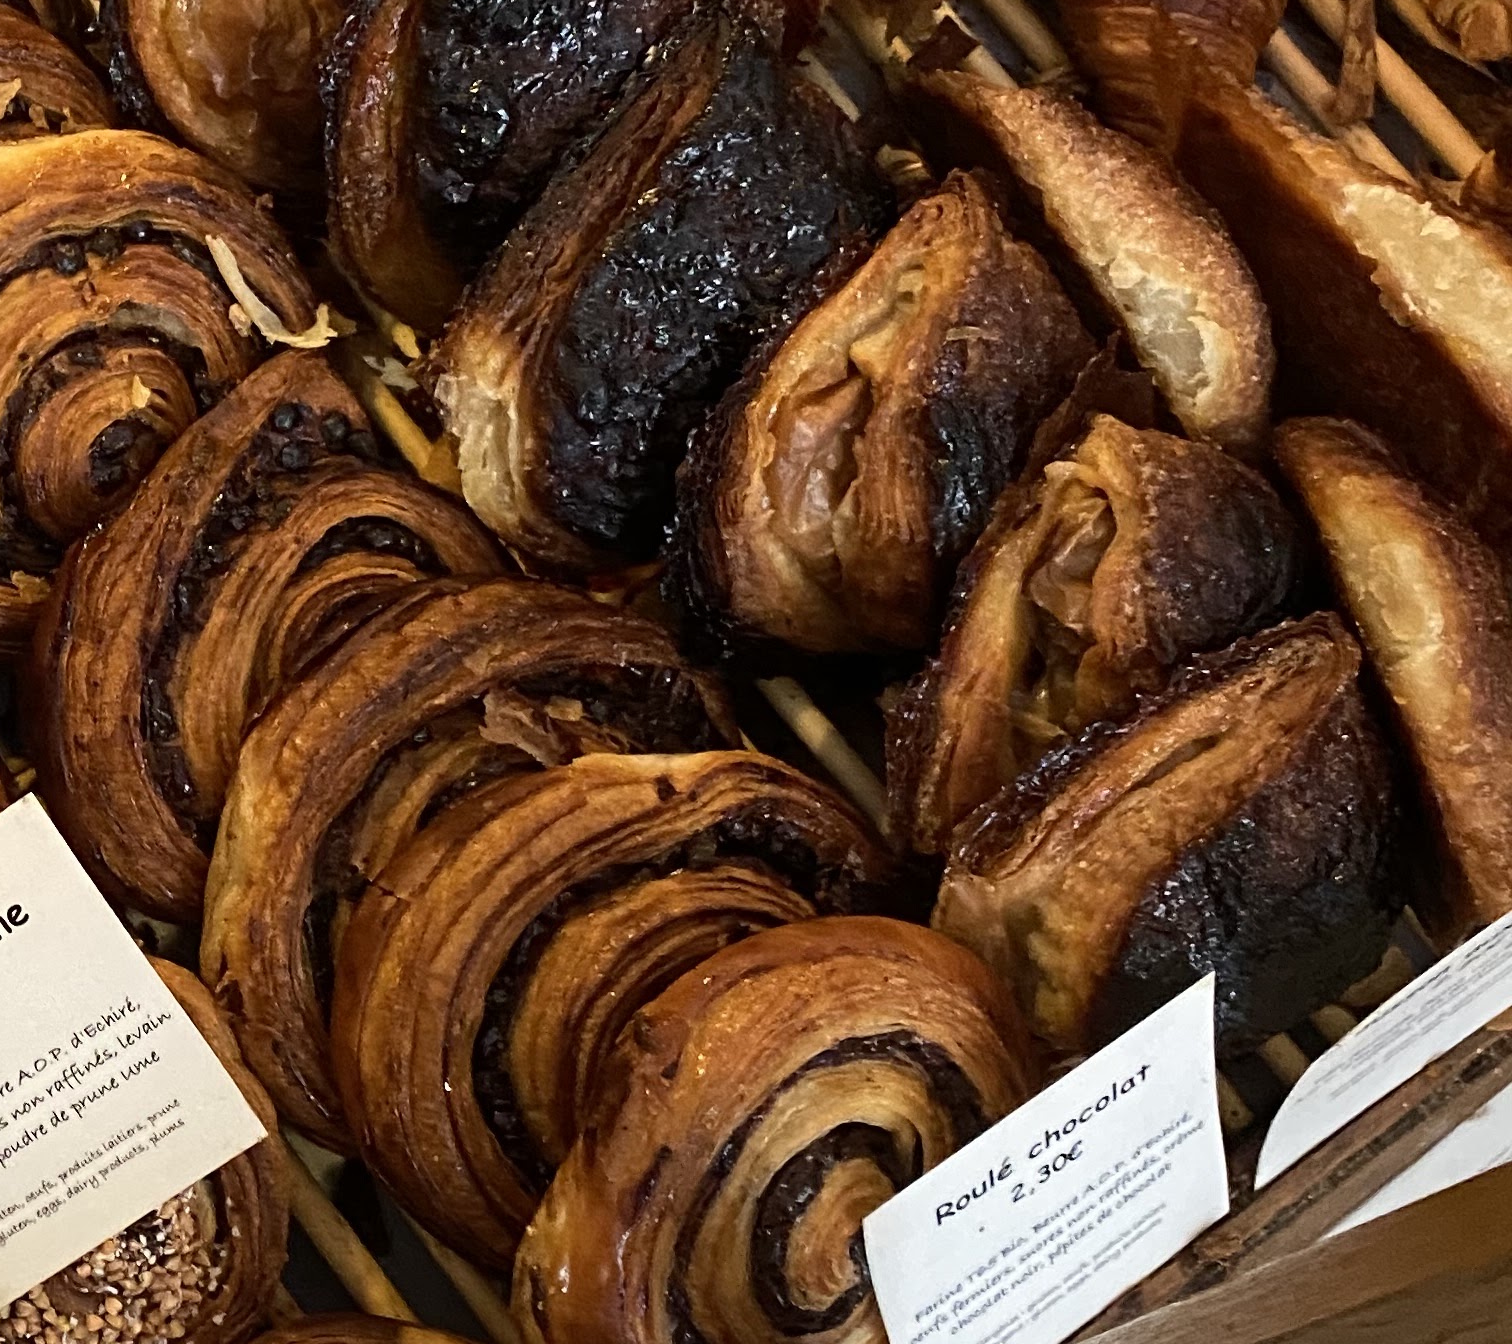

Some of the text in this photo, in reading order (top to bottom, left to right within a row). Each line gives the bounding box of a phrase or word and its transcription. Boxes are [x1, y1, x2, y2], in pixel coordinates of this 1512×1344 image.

[70, 996, 140, 1049] d'Echiré,
[10, 1096, 44, 1121] non
[45, 1048, 118, 1097] raffinés,
[116, 1013, 171, 1049] levain
[50, 1110, 69, 1128] de
[69, 1077, 119, 1118] prune
[120, 1050, 160, 1081] ume
[146, 1098, 180, 1127] prune
[935, 1064, 1150, 1226] Roulé chocolat
[1011, 1139, 1083, 1203] 2,30€
[66, 1175, 100, 1199] dairy
